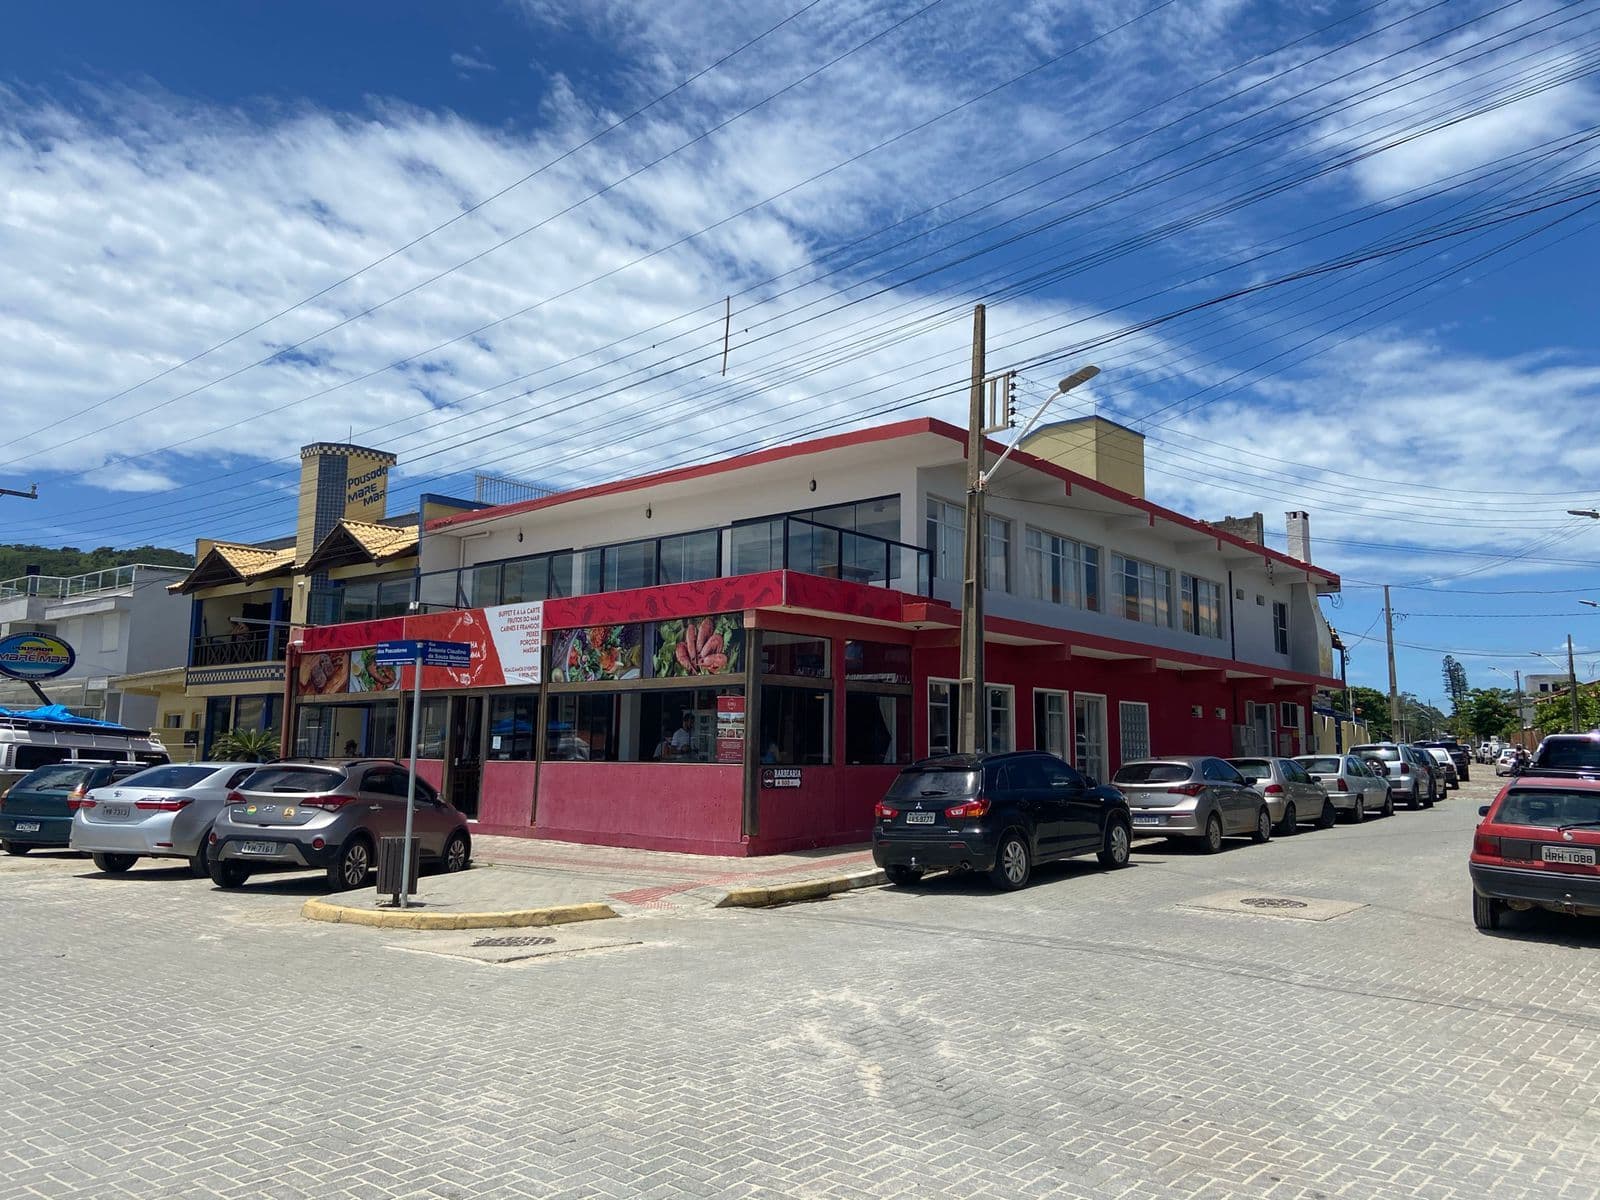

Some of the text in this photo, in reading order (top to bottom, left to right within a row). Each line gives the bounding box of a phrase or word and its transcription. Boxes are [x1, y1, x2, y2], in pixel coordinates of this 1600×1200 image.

[507, 616, 522, 624] FRUTOS
[520, 622, 540, 630] FRANGOS
[774, 769, 801, 778] BARBEARIA
